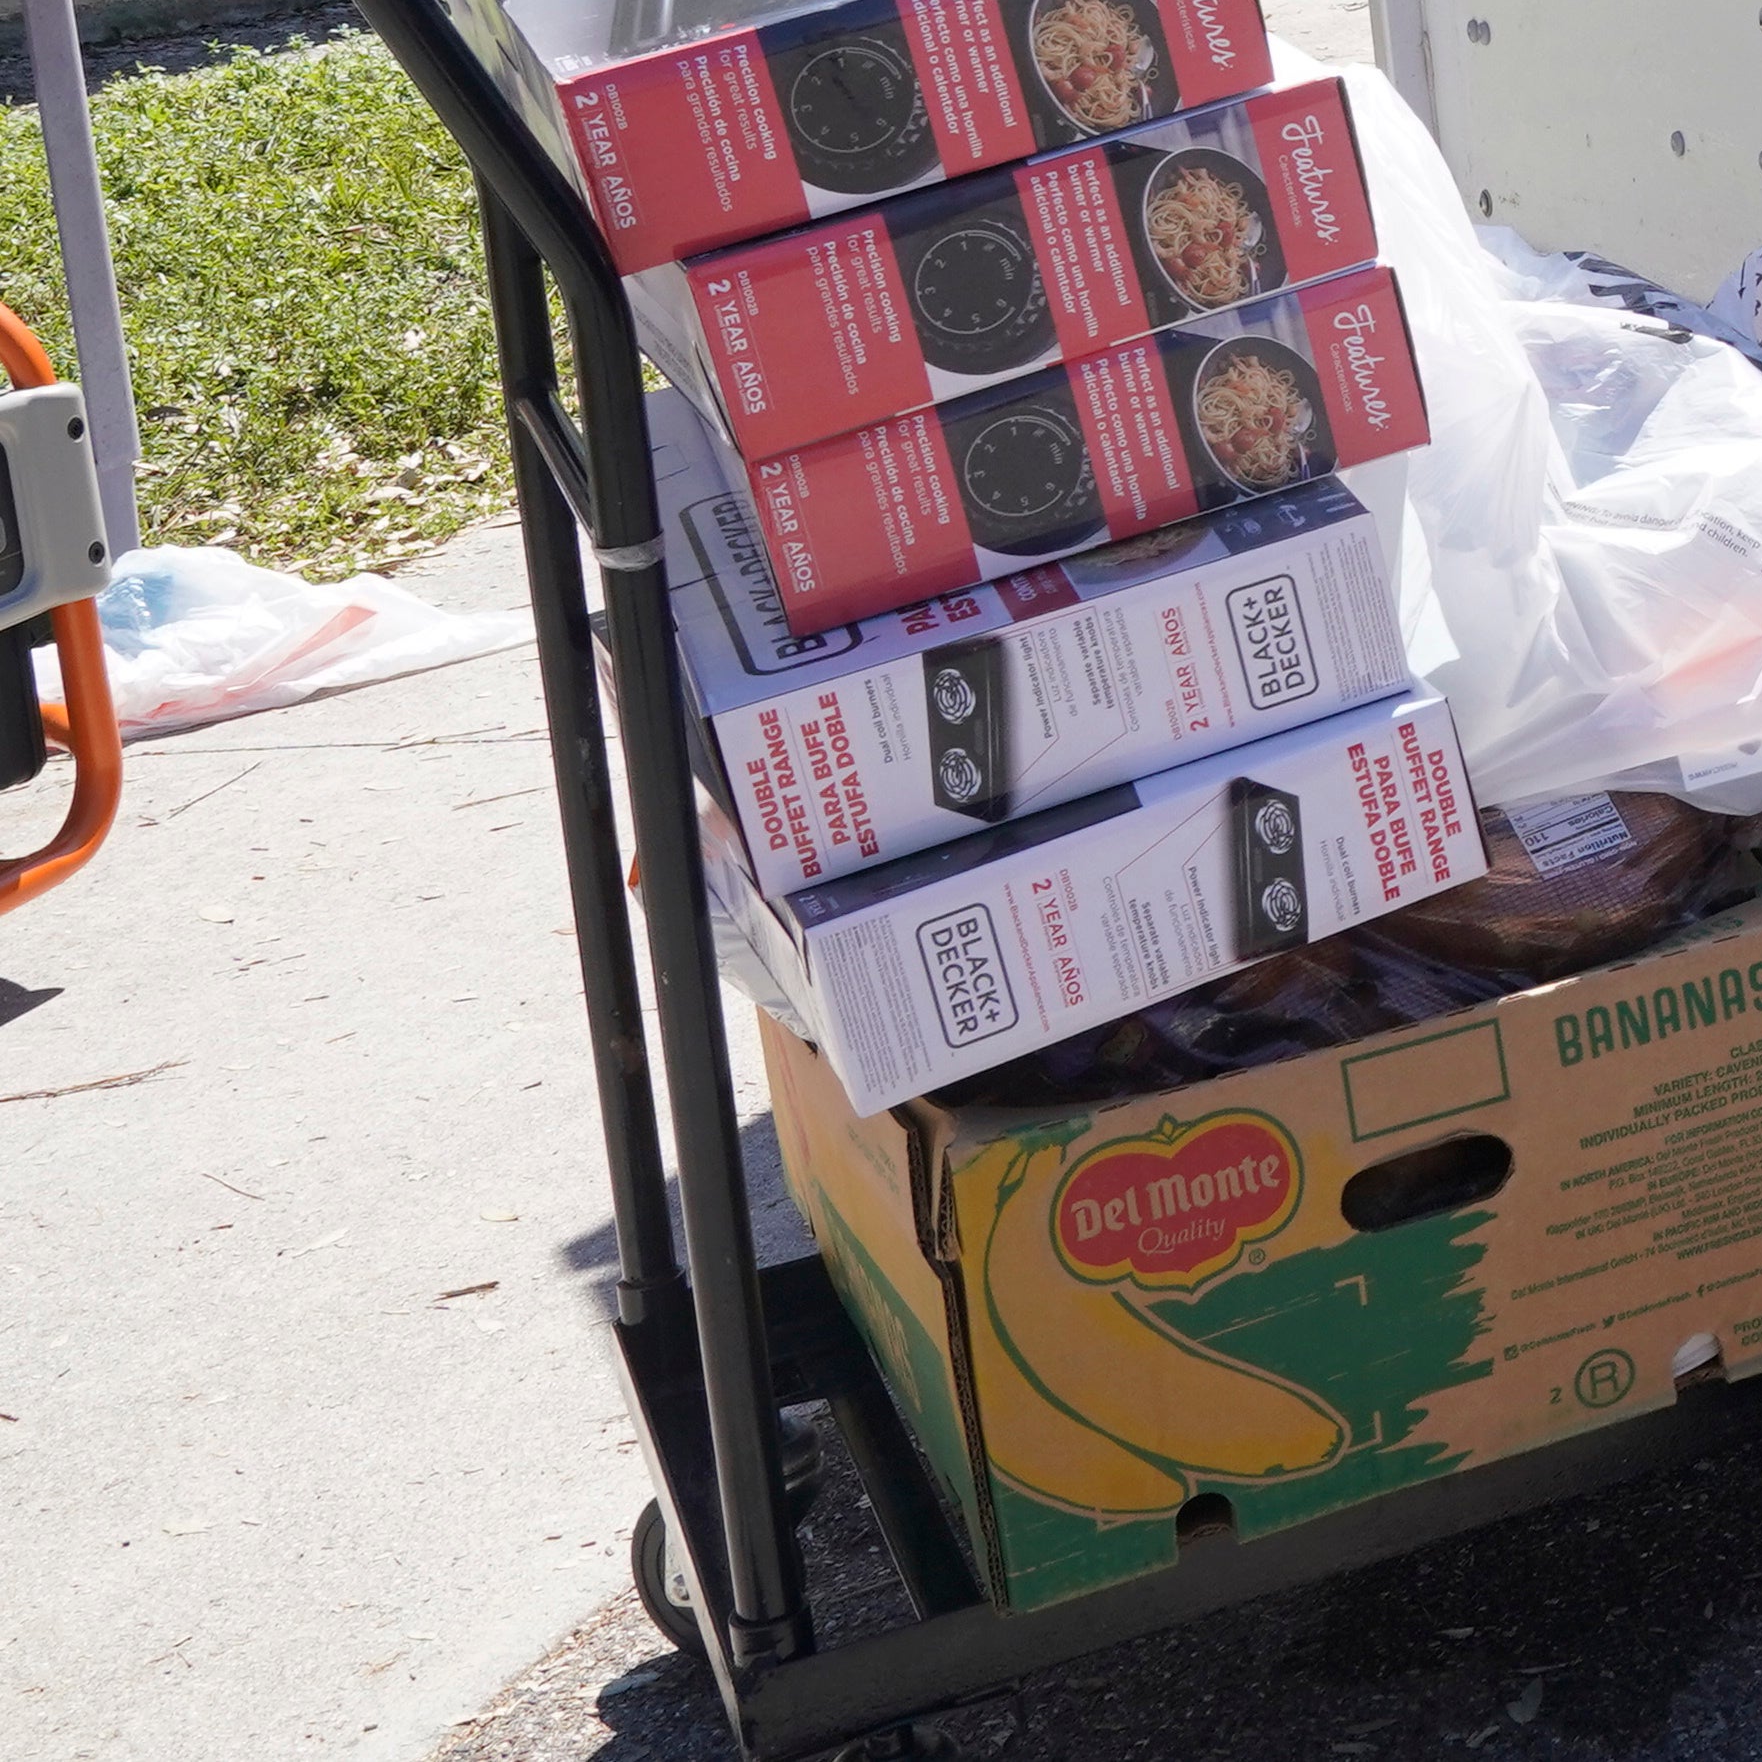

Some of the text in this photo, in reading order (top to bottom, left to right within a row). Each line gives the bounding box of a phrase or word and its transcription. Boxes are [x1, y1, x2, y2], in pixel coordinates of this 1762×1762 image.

[928, 54, 940, 65] o
[942, 45, 962, 83] como
[961, 28, 976, 45] or
[966, 45, 989, 96] warmer
[978, 27, 992, 44] as
[983, 44, 997, 62] an
[675, 59, 736, 212] para grandes resultados
[691, 54, 743, 182] Precisión de cocina
[717, 48, 758, 150] for great results
[732, 43, 779, 161] Precision cooking
[930, 64, 961, 136] calentador
[953, 84, 969, 110] una
[960, 110, 985, 159] hornilla
[988, 62, 1016, 128] additional
[573, 89, 642, 229] 2 YEAR AÑOS
[1280, 112, 1346, 252] Features:
[706, 277, 771, 414] 2 YEAR AÑOS
[1331, 301, 1399, 437] Features:
[759, 459, 817, 593] 2 YEAR AÑOS
[1706, 524, 1750, 558] children.
[1736, 526, 1762, 551] keep
[1157, 605, 1209, 732] 2 YEAR AÑOS
[1239, 593, 1282, 698] BLACK+
[1262, 584, 1305, 690] DECKER
[746, 757, 788, 850] DOUBLE
[759, 708, 822, 878] BUFFET RANGE
[801, 719, 850, 845] PARA BUFE
[818, 690, 879, 857] ESTUFA DOBLE
[1372, 754, 1416, 875] PARA BUFE
[1397, 721, 1450, 883] BUFFET RANGE
[1426, 748, 1461, 837] DOUBLE
[1567, 805, 1613, 827] Calories
[1347, 742, 1400, 902] ESTUFA DOBLE
[1525, 832, 1550, 847] 110
[1541, 851, 1576, 867] Facts
[1577, 830, 1629, 853] Nutrition
[1186, 865, 1222, 967] Power indicator light
[1334, 836, 1362, 915] Dual coil burners
[930, 926, 980, 1036] DECKER
[954, 916, 1005, 1027] BLACK+
[1001, 881, 1052, 1033] www.BlackandDeckerAppliances.com
[1031, 876, 1088, 1006] 2 YEAR AÑOS
[1101, 875, 1143, 998] Controles de temperatura
[1126, 898, 1160, 990] temperature knobs
[1139, 901, 1171, 986] Separate variable
[1579, 1112, 1670, 1151] INDIVIDUALLY
[1673, 1094, 1728, 1122] PACKED
[1633, 1090, 1693, 1119] MINIMUM
[1695, 1072, 1752, 1100] LENGTH:
[1653, 1069, 1713, 1097] VARIETY:
[1069, 1145, 1282, 1245] Del Monte
[1135, 1205, 1228, 1263] Quality
[1547, 1386, 1562, 1406] 2
